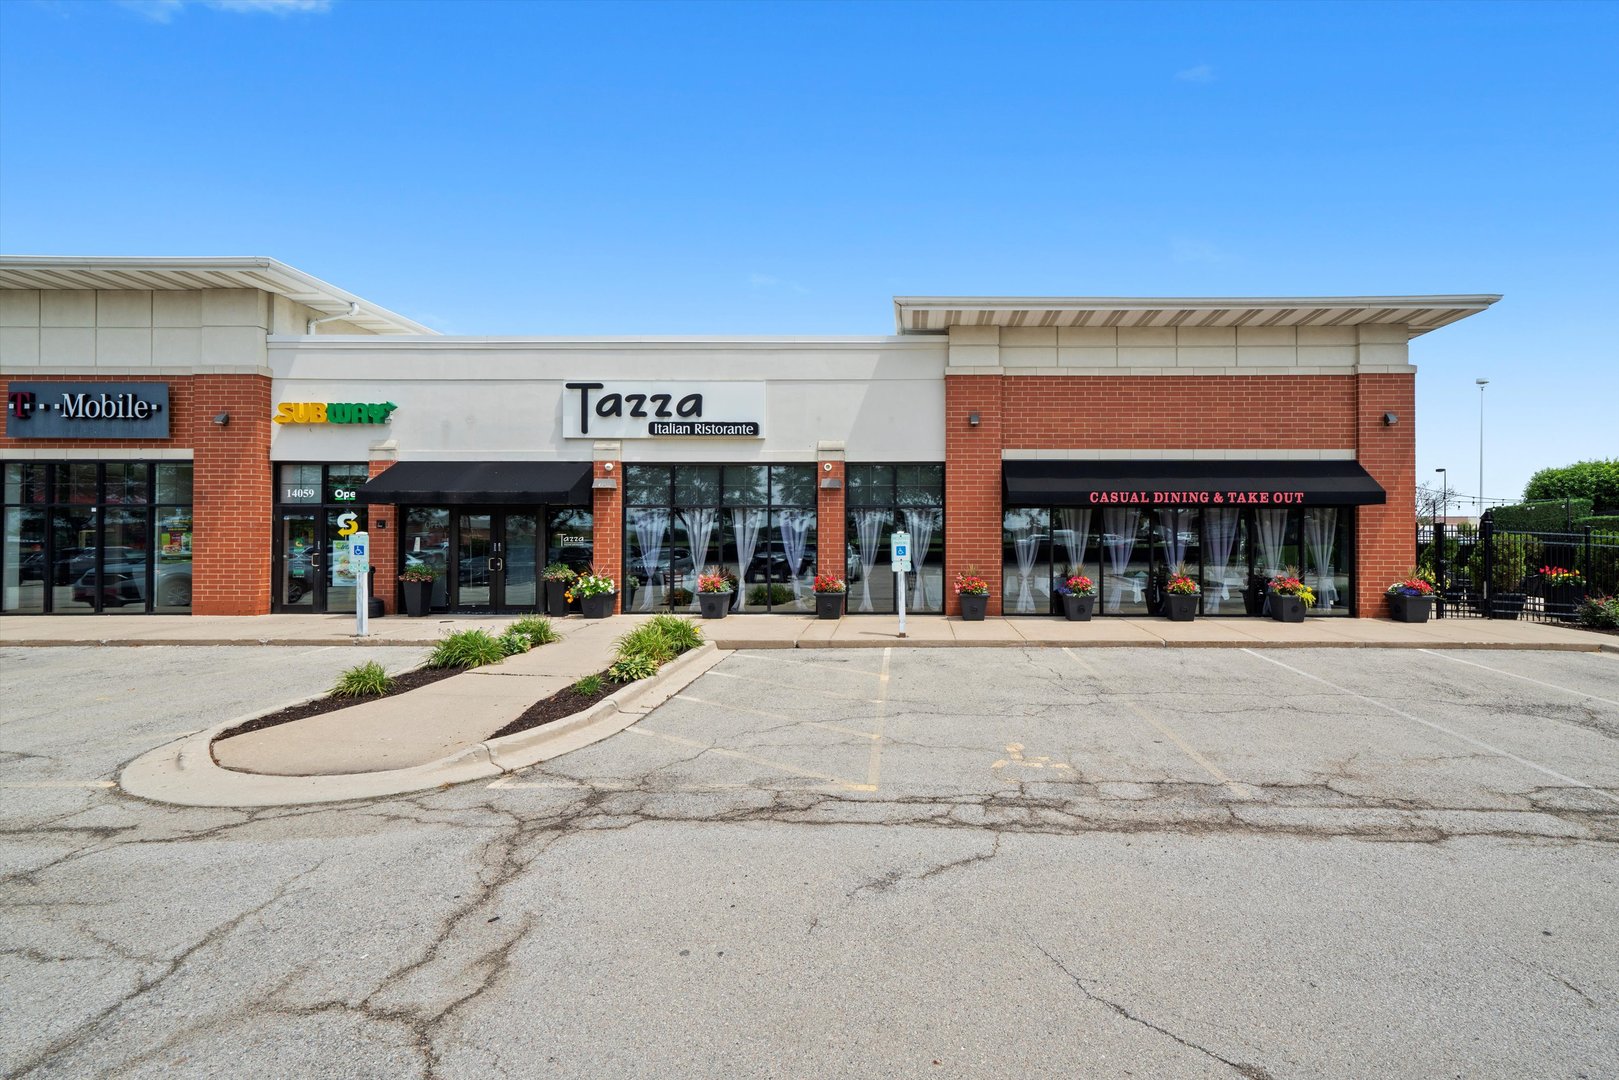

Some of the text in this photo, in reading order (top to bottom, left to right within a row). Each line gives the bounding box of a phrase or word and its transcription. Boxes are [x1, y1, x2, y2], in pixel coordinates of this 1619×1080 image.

[272, 401, 398, 425] SUBWAY
[565, 382, 703, 435] Tazza
[654, 422, 754, 435] Italian Ristorante
[286, 489, 315, 498] 14059
[334, 489, 356, 500] Ope
[1089, 491, 1304, 503] CASUAL DINING & TAKE OUT
[556, 533, 584, 547] Tazza
